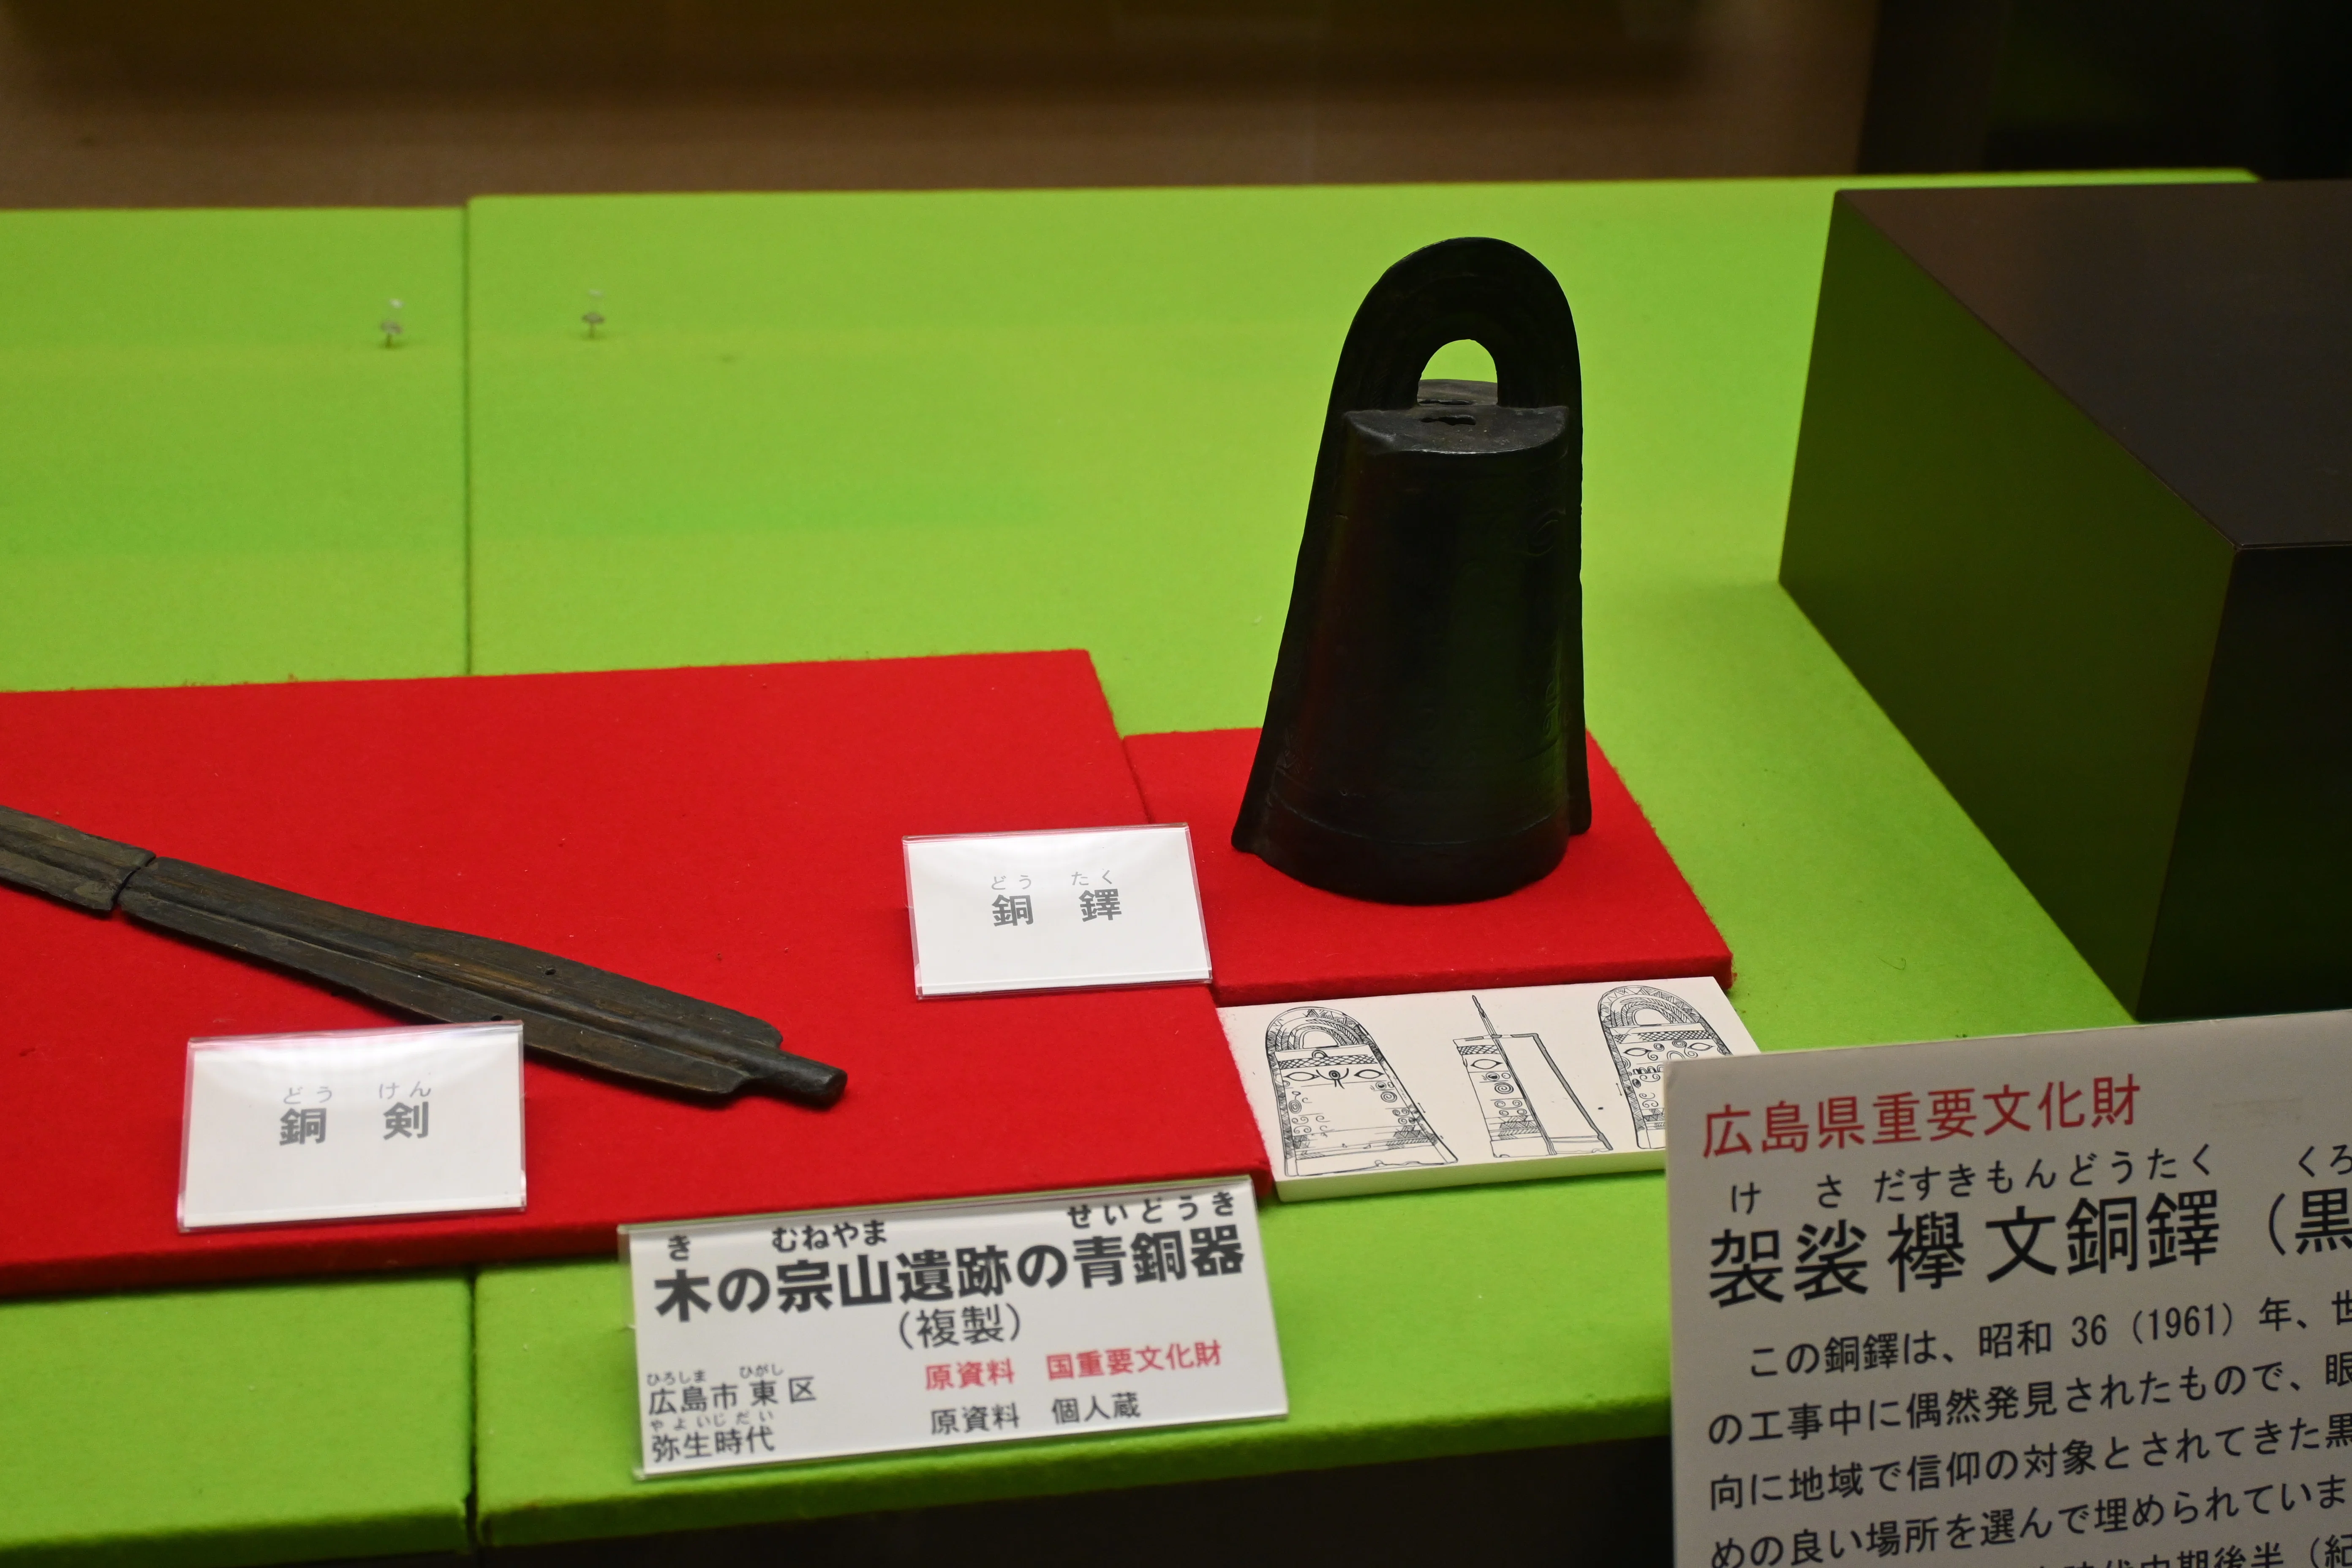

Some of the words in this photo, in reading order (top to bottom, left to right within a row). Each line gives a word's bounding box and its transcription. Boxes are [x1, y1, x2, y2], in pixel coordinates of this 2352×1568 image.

[1703, 1073, 2140, 1158] 広島県重要文化財
[772, 1219, 887, 1252] むねやま
[1067, 1191, 1235, 1229] せいどうき
[655, 1224, 1245, 1322] 木の宗山遺跡の青銅器
[926, 1358, 1014, 1390] 原資料
[1046, 1340, 1220, 1380] 国重要文化財
[931, 1402, 1019, 1435] 原資料
[1051, 1391, 1141, 1424] 個人蔵
[652, 1425, 774, 1462] 弥生時代
